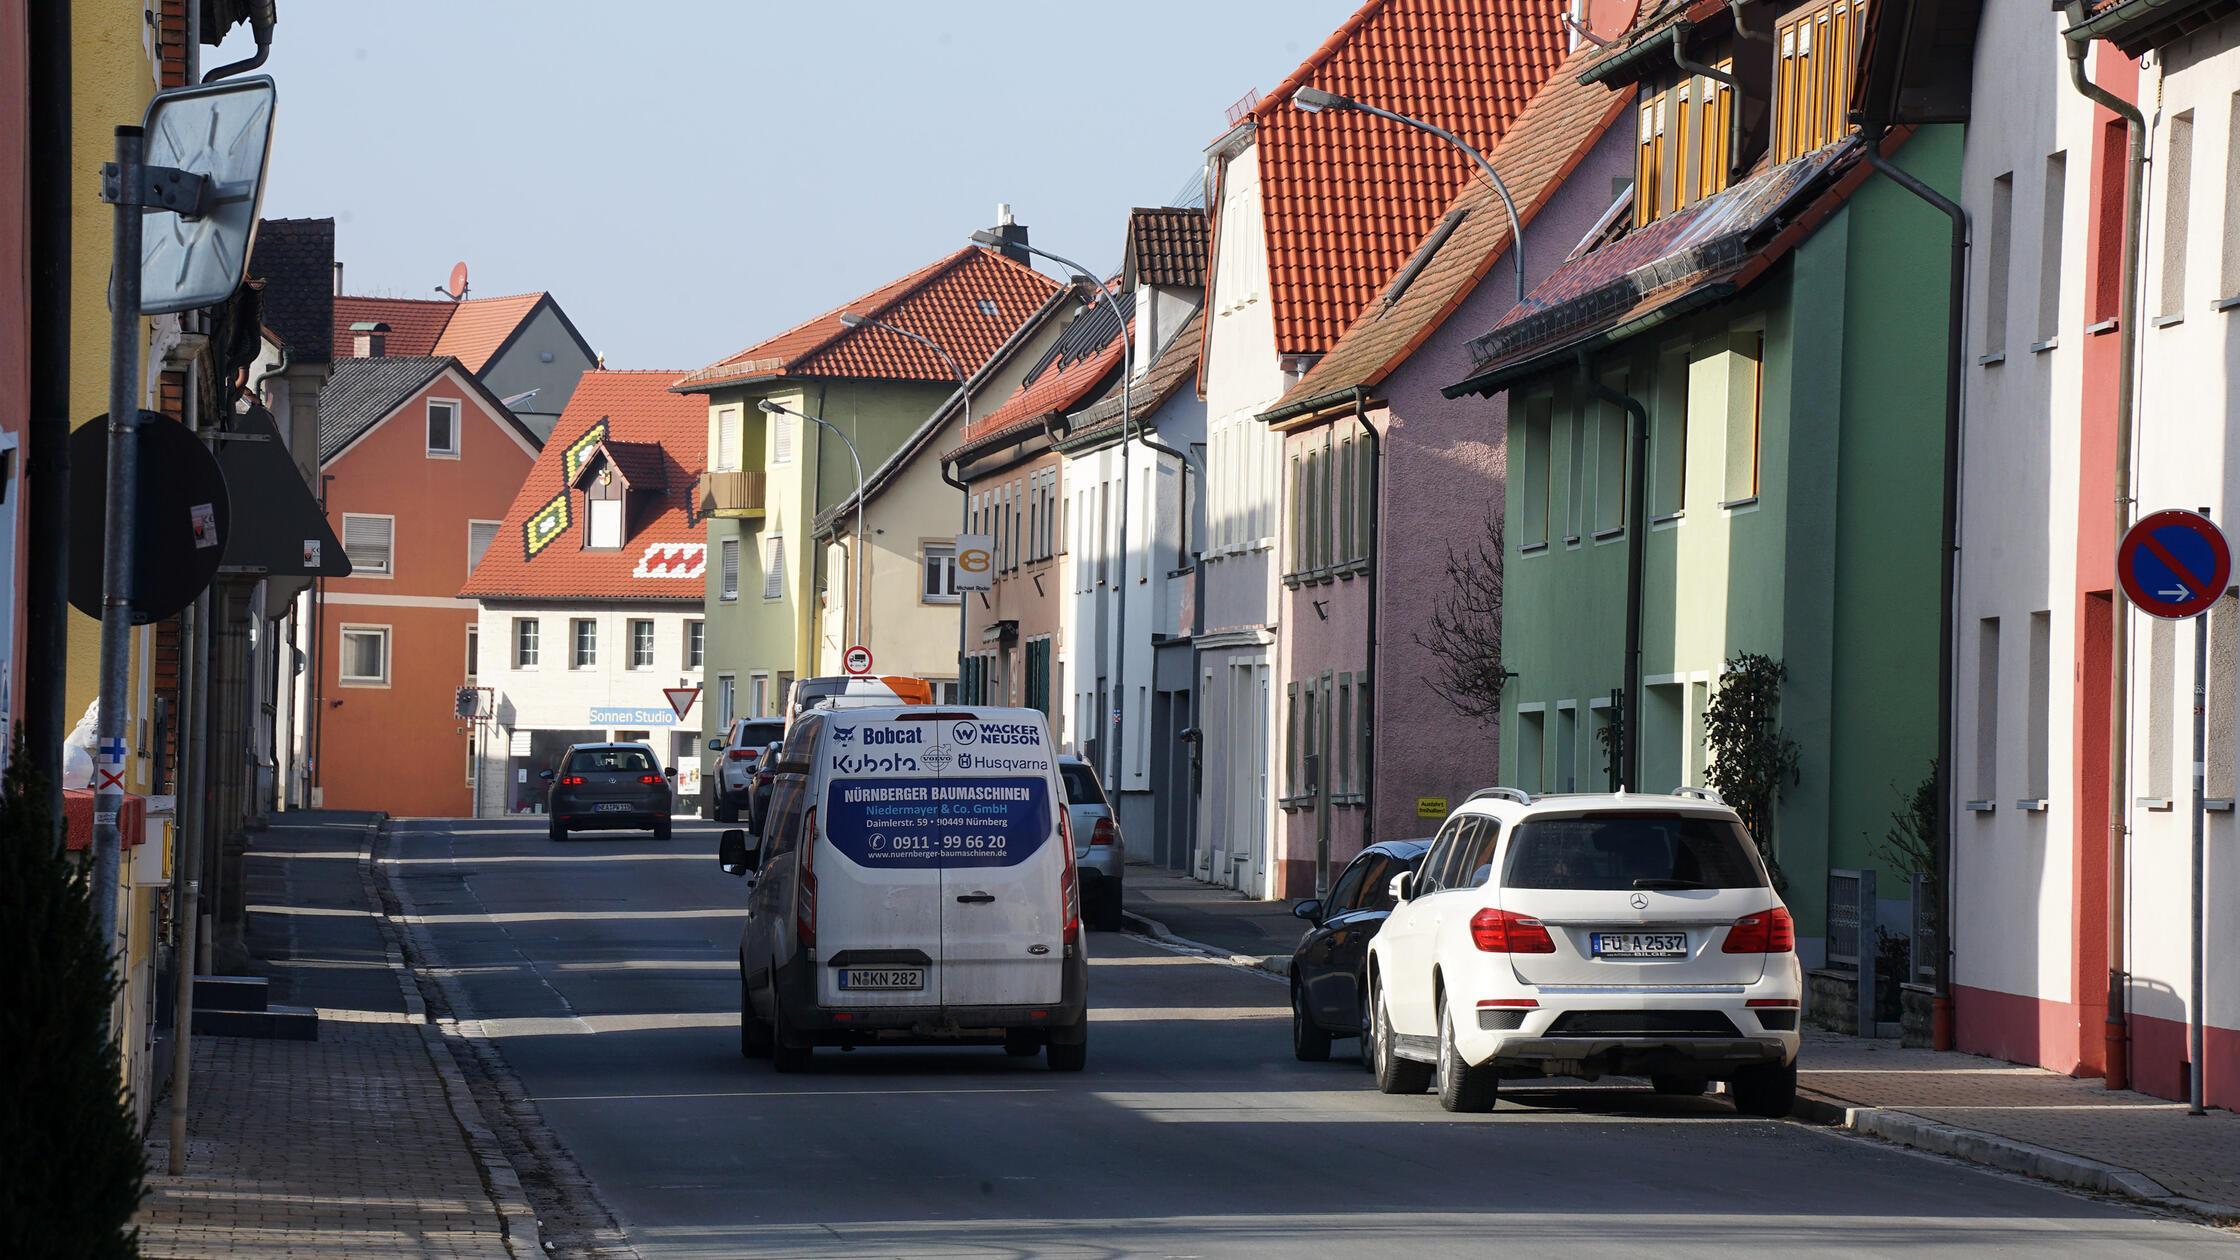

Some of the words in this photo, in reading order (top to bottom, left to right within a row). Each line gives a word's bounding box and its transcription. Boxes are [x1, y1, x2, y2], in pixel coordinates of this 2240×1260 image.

[590, 710, 632, 722] Sonnen
[635, 711, 672, 722] Studio
[863, 727, 922, 744] Bobcat
[980, 724, 1038, 735] WACKER
[981, 735, 1040, 745] NEUSON
[975, 757, 1048, 771] Husqvarna
[845, 787, 927, 802] NÜRNBERGER
[932, 787, 1030, 801] BAUMASCHINEN
[866, 805, 938, 818] Niedermayer
[942, 804, 949, 814] &
[953, 804, 970, 814] Co.
[974, 804, 1008, 814] GmbH
[866, 819, 914, 827] Daimlerstr.
[966, 818, 1008, 828] Nürnberg
[893, 836, 929, 849] 0911
[943, 837, 961, 848] 99
[966, 836, 984, 848] 66
[988, 836, 1006, 848] 20
[868, 849, 1007, 859] www.nuernberger-baumaschinen.de
[1602, 935, 1621, 950] FÜ
[1633, 936, 1642, 950] A
[1646, 936, 1683, 950] 2537
[853, 972, 861, 985] N
[871, 972, 888, 985] KN
[892, 972, 916, 985] 282
